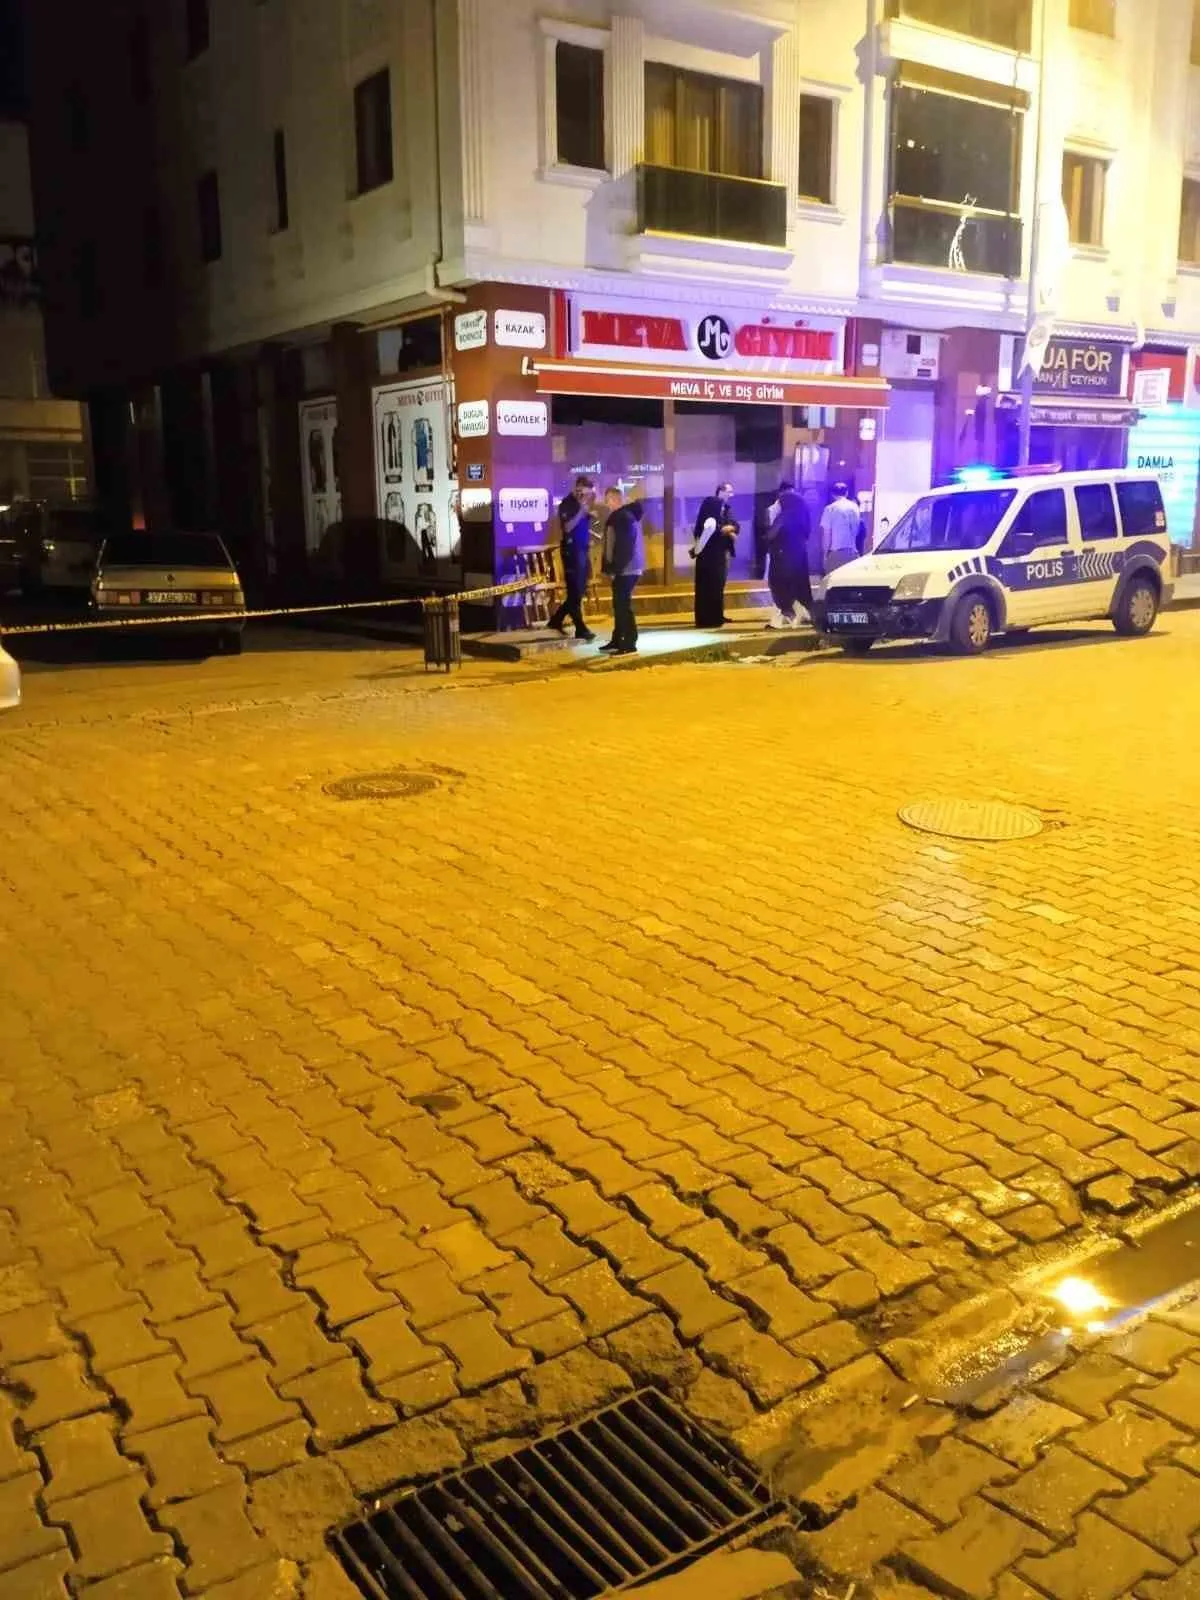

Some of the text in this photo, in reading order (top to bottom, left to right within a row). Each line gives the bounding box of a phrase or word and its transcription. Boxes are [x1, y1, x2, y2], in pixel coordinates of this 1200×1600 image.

[505, 323, 535, 336] KAZAK
[1042, 345, 1112, 372] UAFÖR
[670, 382, 700, 395] MEVA
[704, 380, 715, 399] İÇ
[718, 384, 732, 396] VE
[756, 384, 784, 400] GİYİM
[1137, 456, 1174, 469] DAMLA
